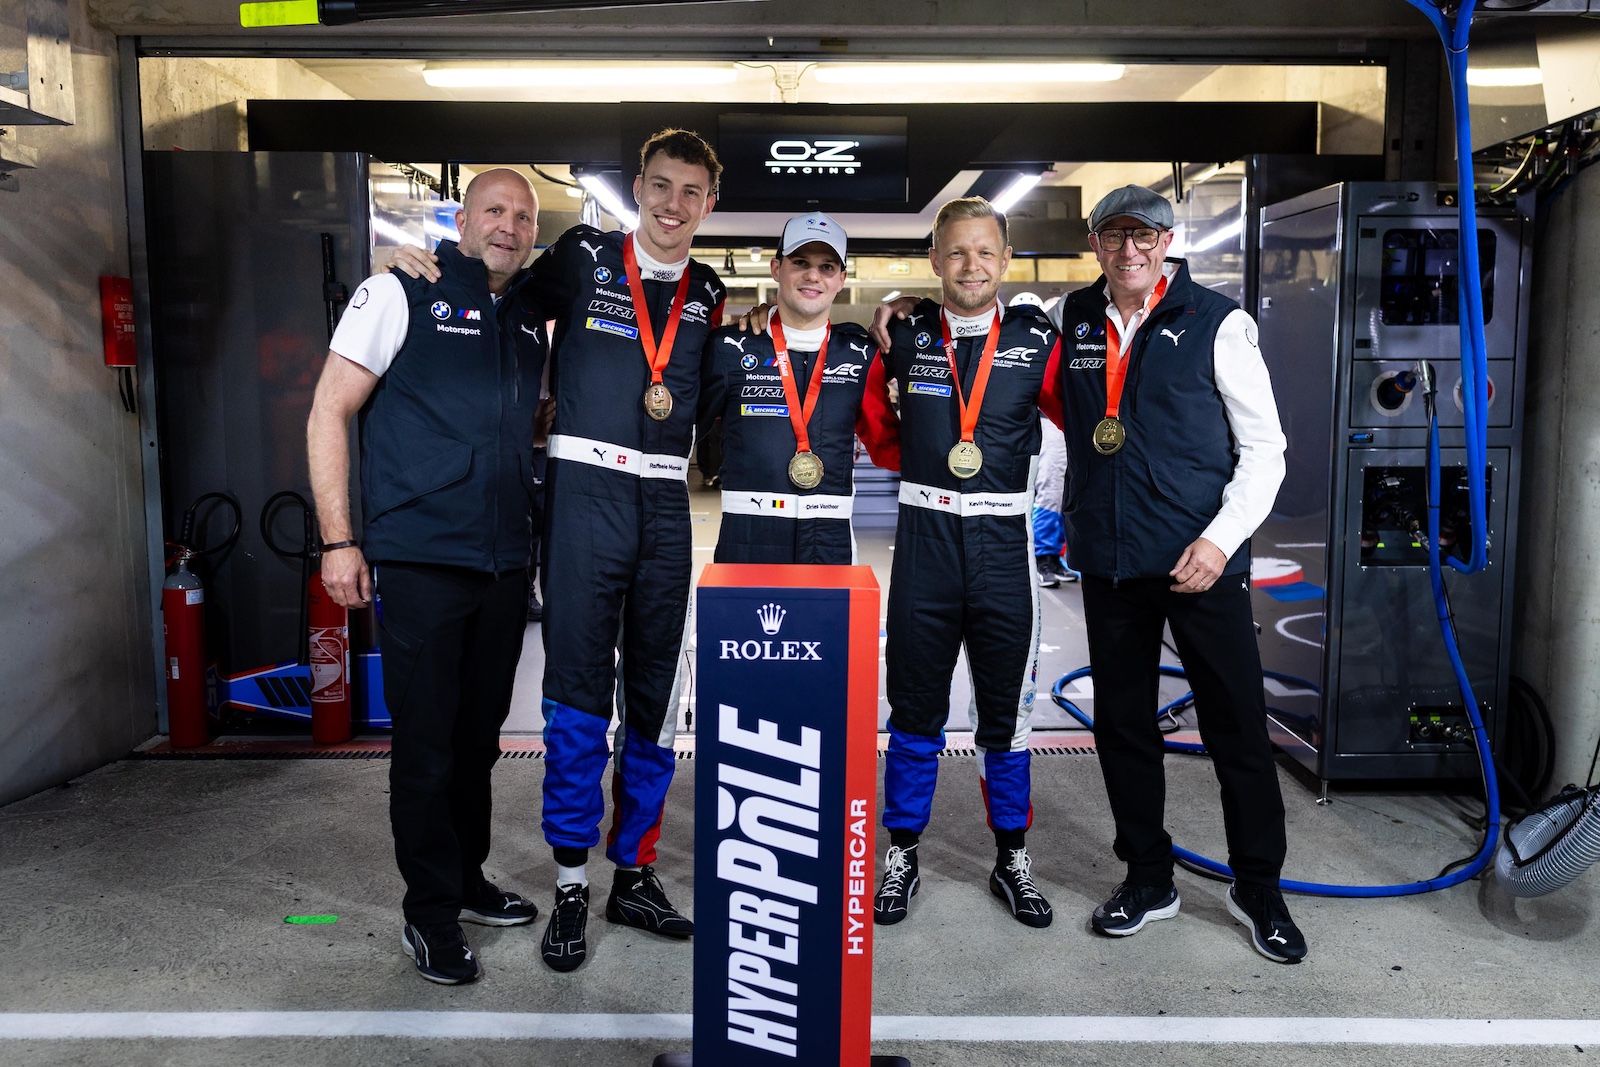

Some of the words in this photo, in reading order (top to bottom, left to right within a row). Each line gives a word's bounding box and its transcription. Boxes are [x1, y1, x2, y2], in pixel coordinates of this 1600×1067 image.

[595, 287, 633, 302] Motorspor
[436, 324, 481, 336] Motorsport
[601, 322, 634, 335] MICHELIN
[1076, 343, 1106, 351] Motorspor
[916, 352, 949, 363] Motorspo
[1069, 357, 1107, 369] WRT
[745, 373, 782, 382] Motorspor
[909, 364, 953, 379] WRT
[741, 385, 785, 398] WRT
[719, 639, 823, 661] ROLEX
[717, 703, 821, 1058] HYPERPOLE
[847, 798, 867, 955] HYPERCAR
